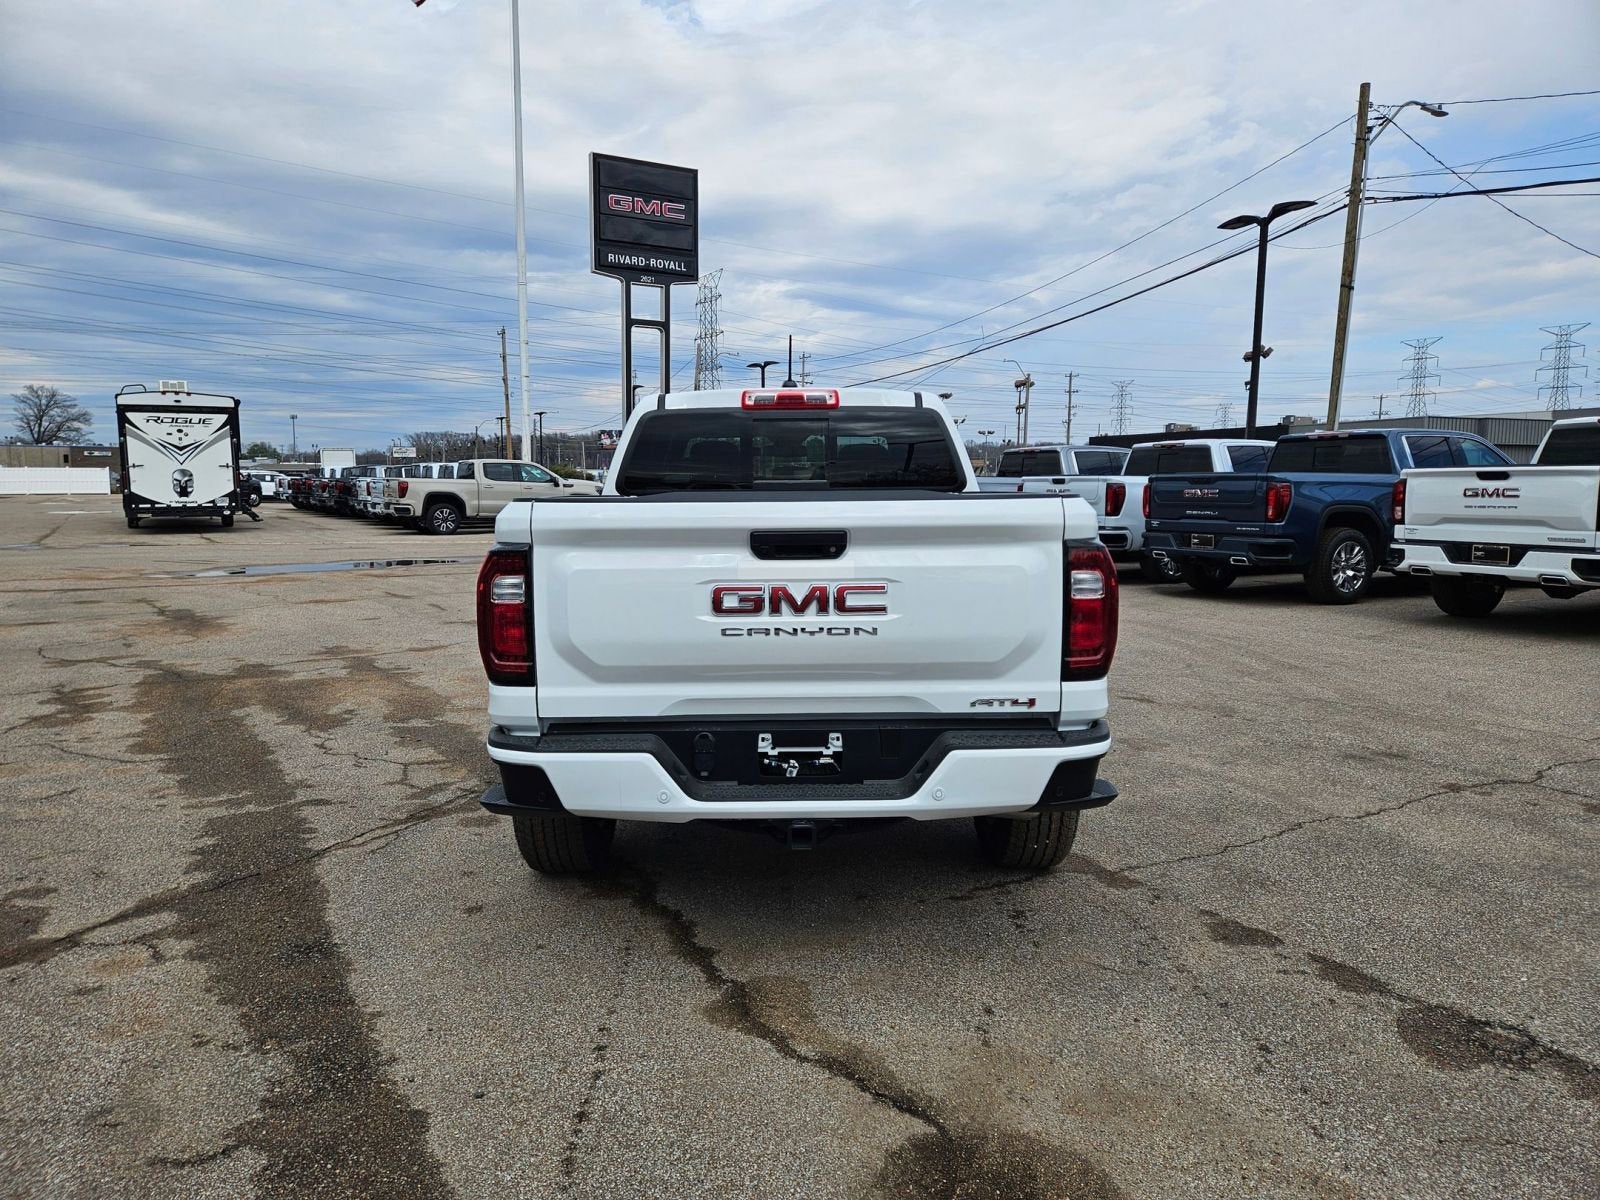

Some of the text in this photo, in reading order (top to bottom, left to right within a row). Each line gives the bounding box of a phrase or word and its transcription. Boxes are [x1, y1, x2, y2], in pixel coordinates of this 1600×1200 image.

[608, 194, 685, 220] GMC
[608, 253, 687, 271] RIVARD-ROYALL
[143, 415, 215, 425] ROGUE
[1183, 488, 1219, 498] GMC
[1463, 487, 1521, 499] GMC
[711, 583, 888, 616] GMC
[720, 626, 878, 637] CANYON
[969, 698, 1036, 709] AT4
